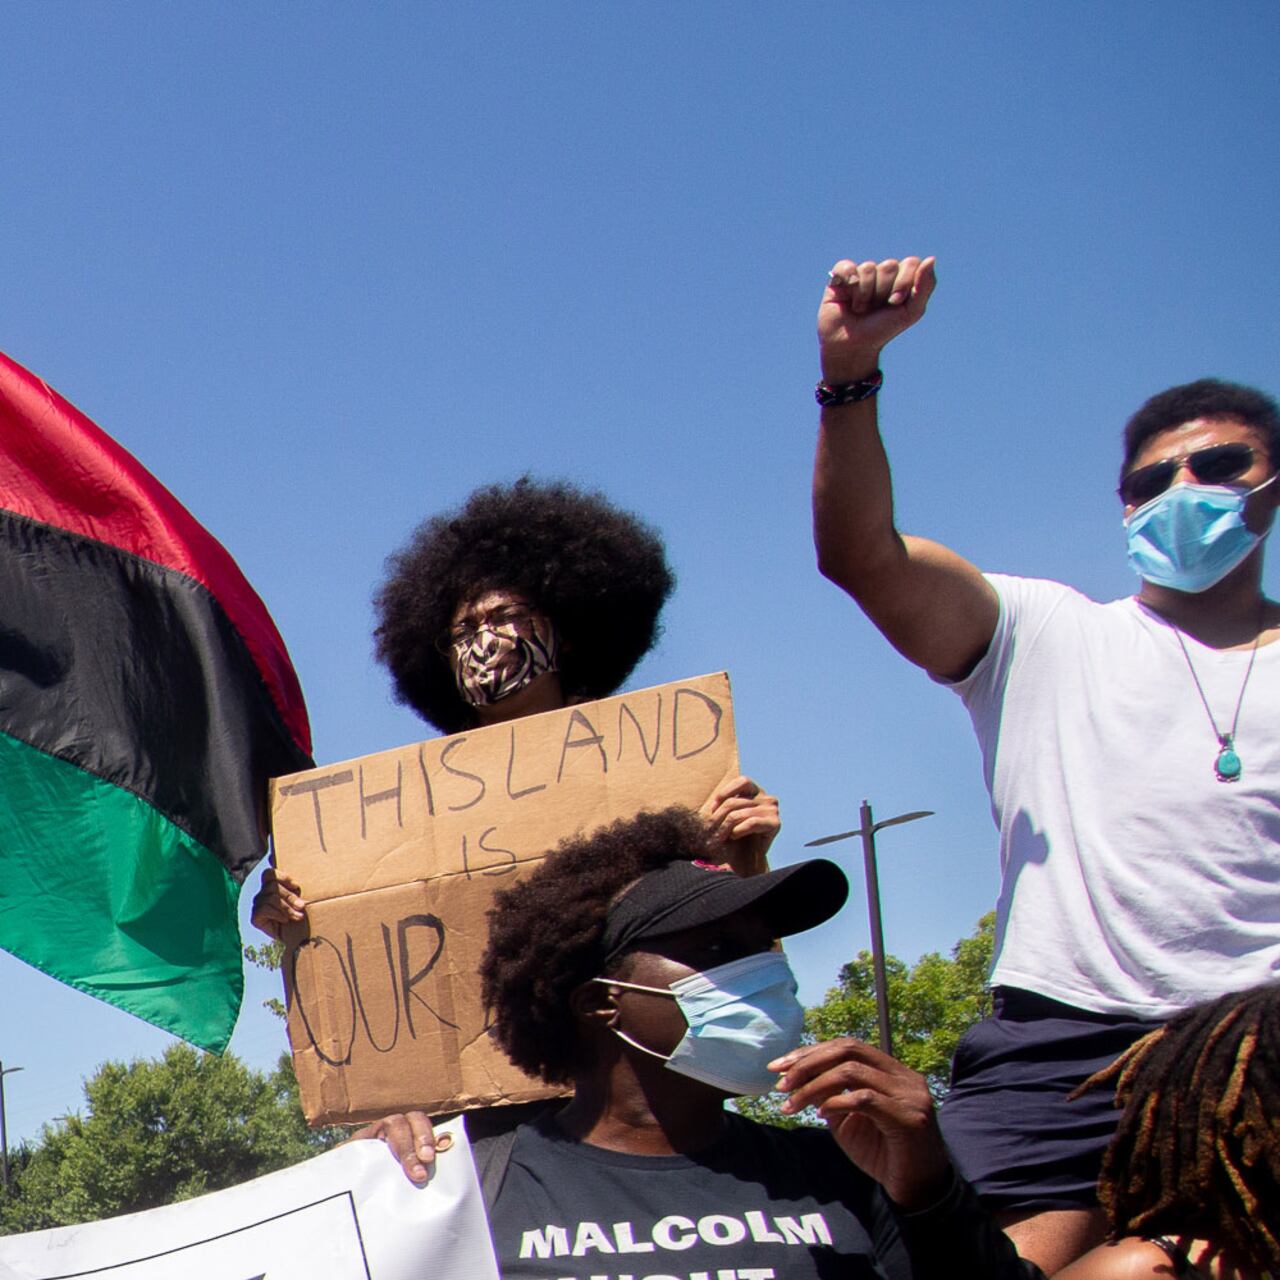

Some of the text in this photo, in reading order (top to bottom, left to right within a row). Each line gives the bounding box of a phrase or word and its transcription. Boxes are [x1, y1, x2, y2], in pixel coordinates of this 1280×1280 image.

[505, 686, 725, 800] LAND
[461, 826, 517, 881] IS
[291, 912, 462, 1067] OUR
[518, 1210, 833, 1260] MALCOLM
